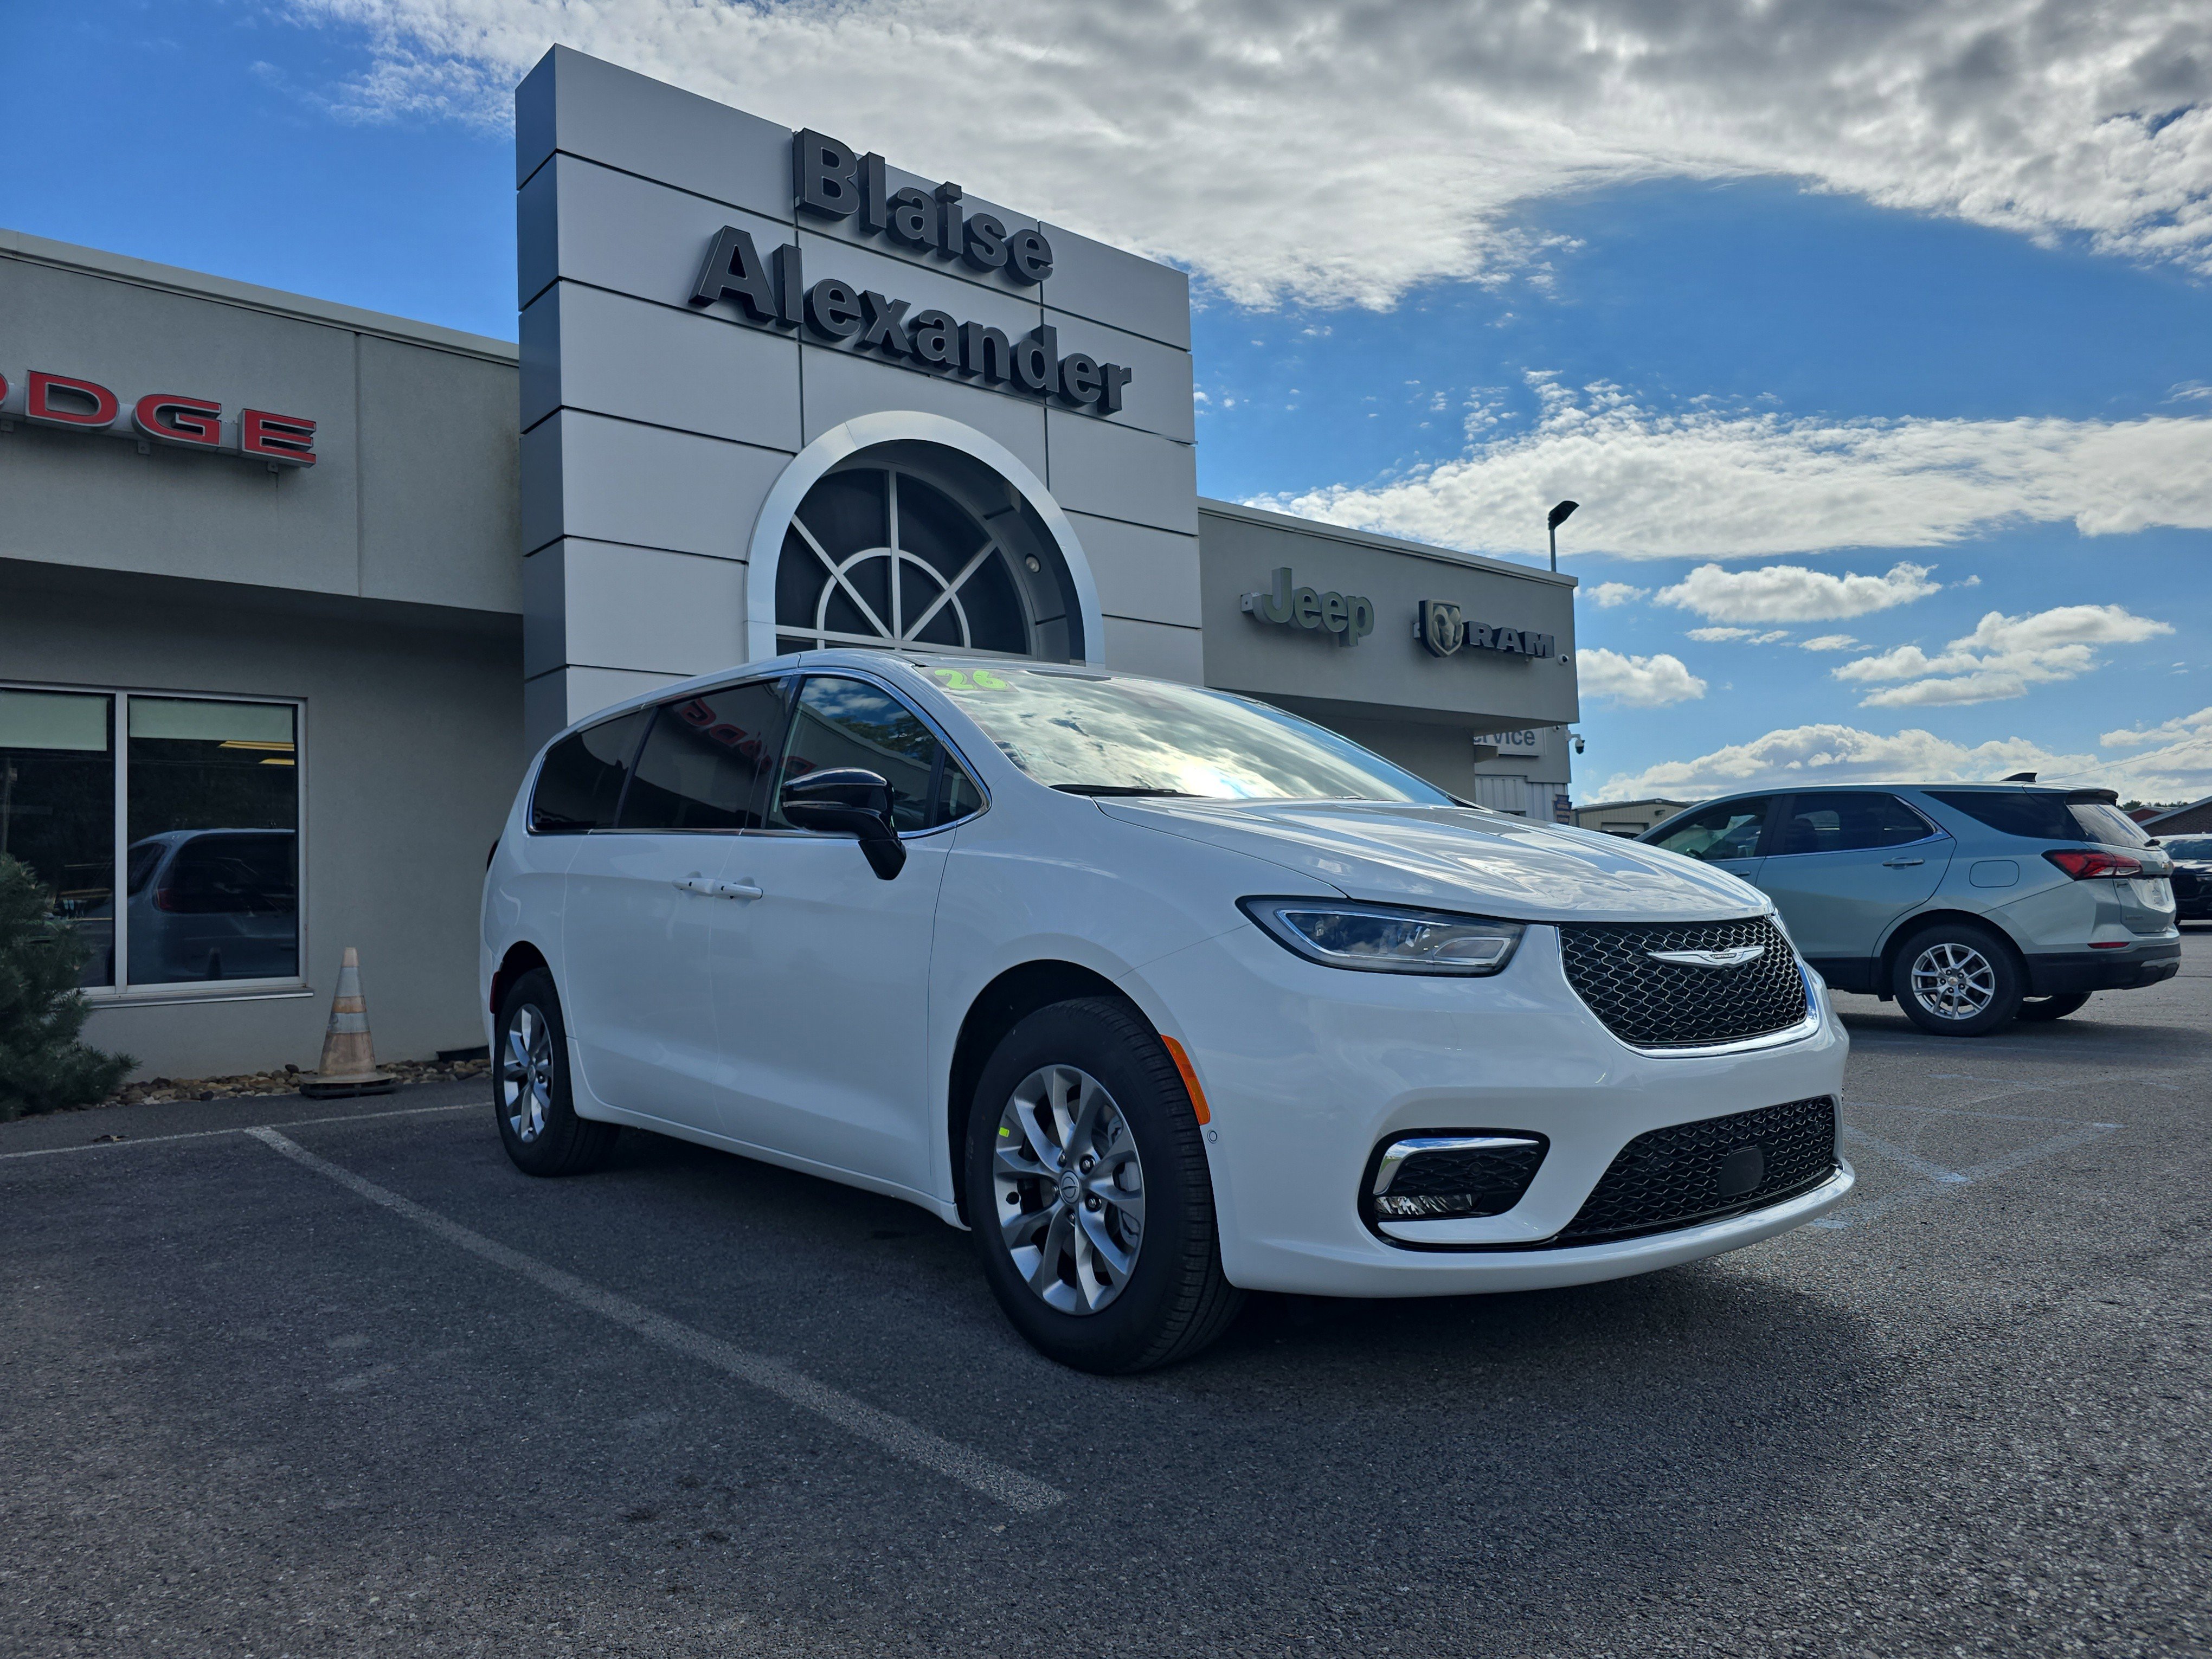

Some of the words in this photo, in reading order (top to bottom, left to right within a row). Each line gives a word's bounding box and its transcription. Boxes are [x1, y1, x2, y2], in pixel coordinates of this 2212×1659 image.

[793, 127, 1053, 286] Blaise
[689, 226, 1132, 414] Alexander
[0, 370, 316, 468] DGE
[1252, 568, 1374, 647] Jeep
[1464, 621, 1555, 658] RAM
[934, 669, 1008, 690] 26
